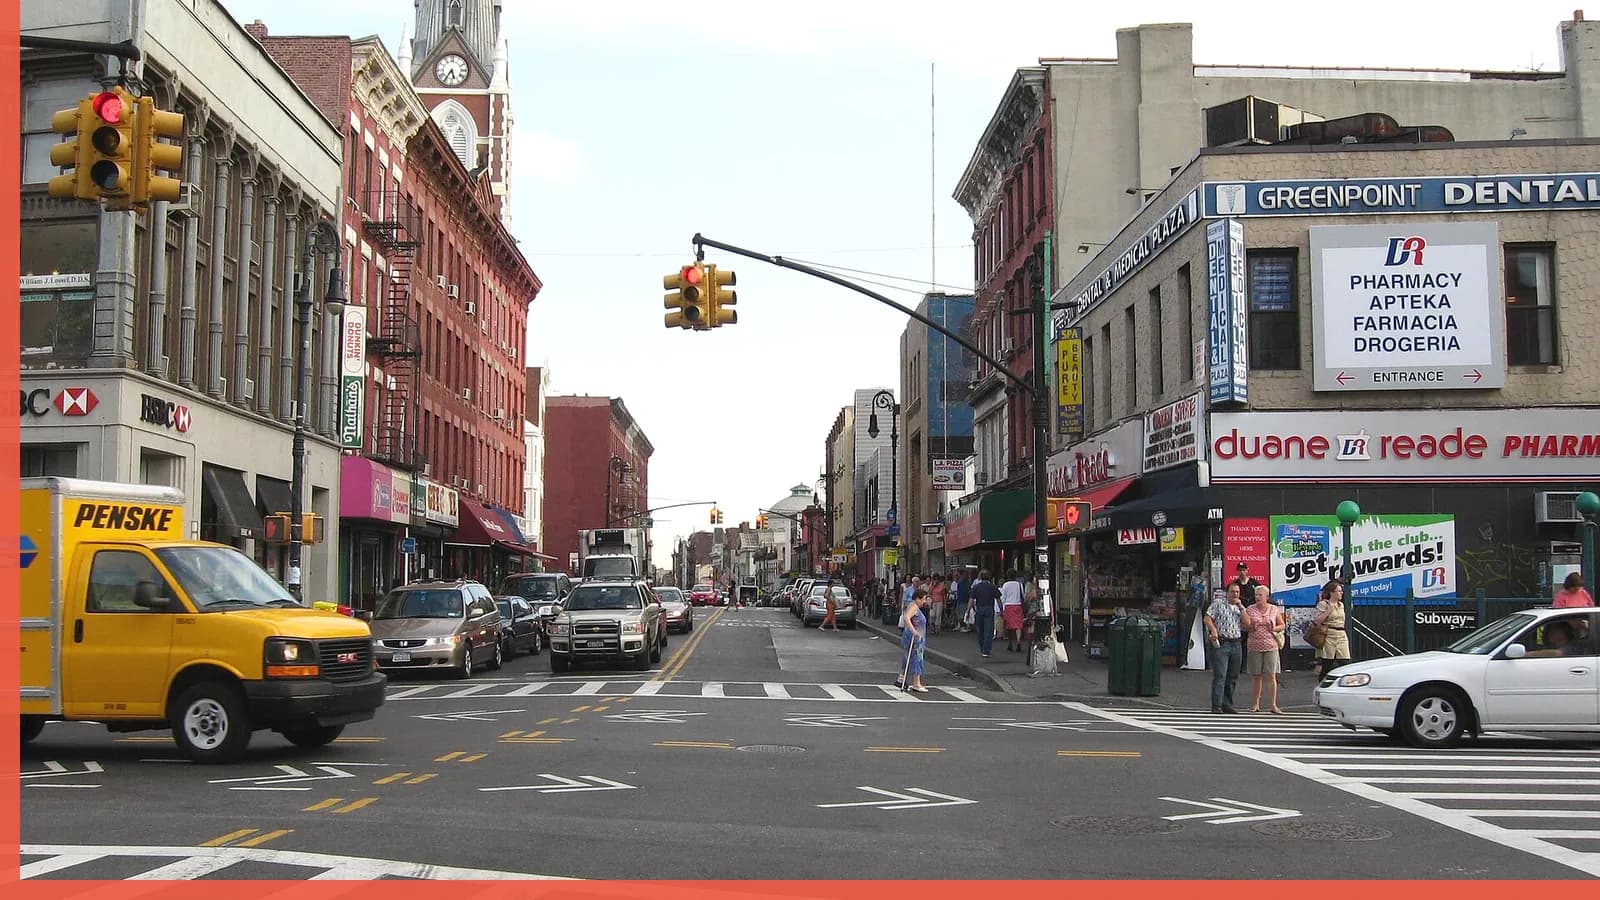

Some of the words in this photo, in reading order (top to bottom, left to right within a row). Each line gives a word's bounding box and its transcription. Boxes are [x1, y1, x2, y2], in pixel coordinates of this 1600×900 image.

[1258, 183, 1421, 209] GREENPOINT
[1445, 179, 1600, 205] DENTAL
[1077, 277, 1102, 314] DENTAL
[1105, 270, 1112, 289] &
[1114, 236, 1150, 282] MEDICAL
[1152, 205, 1185, 249] PLAZA
[1384, 237, 1426, 266] DR
[1350, 272, 1462, 290] PHARMACY
[1209, 243, 1219, 347] DENTAL
[1218, 239, 1227, 363] MEDICAL
[1238, 241, 1246, 364] MEDICAL
[1369, 294, 1451, 310] APTEKA
[1061, 328, 1078, 340] SPA
[1353, 315, 1458, 332] FARMACIA
[1354, 336, 1461, 353] DROGERIA
[1373, 371, 1444, 383] ENTRANCE
[140, 394, 175, 428] HSBC
[1174, 397, 1196, 423] STORE
[1214, 428, 1329, 460] duane
[1380, 427, 1488, 459] reade
[1502, 435, 1600, 457] PHARM
[74, 504, 174, 532] PENSKE
[1208, 508, 1224, 520] ATM
[1120, 528, 1156, 542] ATM
[1368, 537, 1392, 554] the
[1398, 531, 1443, 546] club...
[1285, 552, 1328, 584] get
[1422, 567, 1446, 588] DR
[1371, 582, 1392, 593] today!
[1415, 612, 1467, 626] Subway
